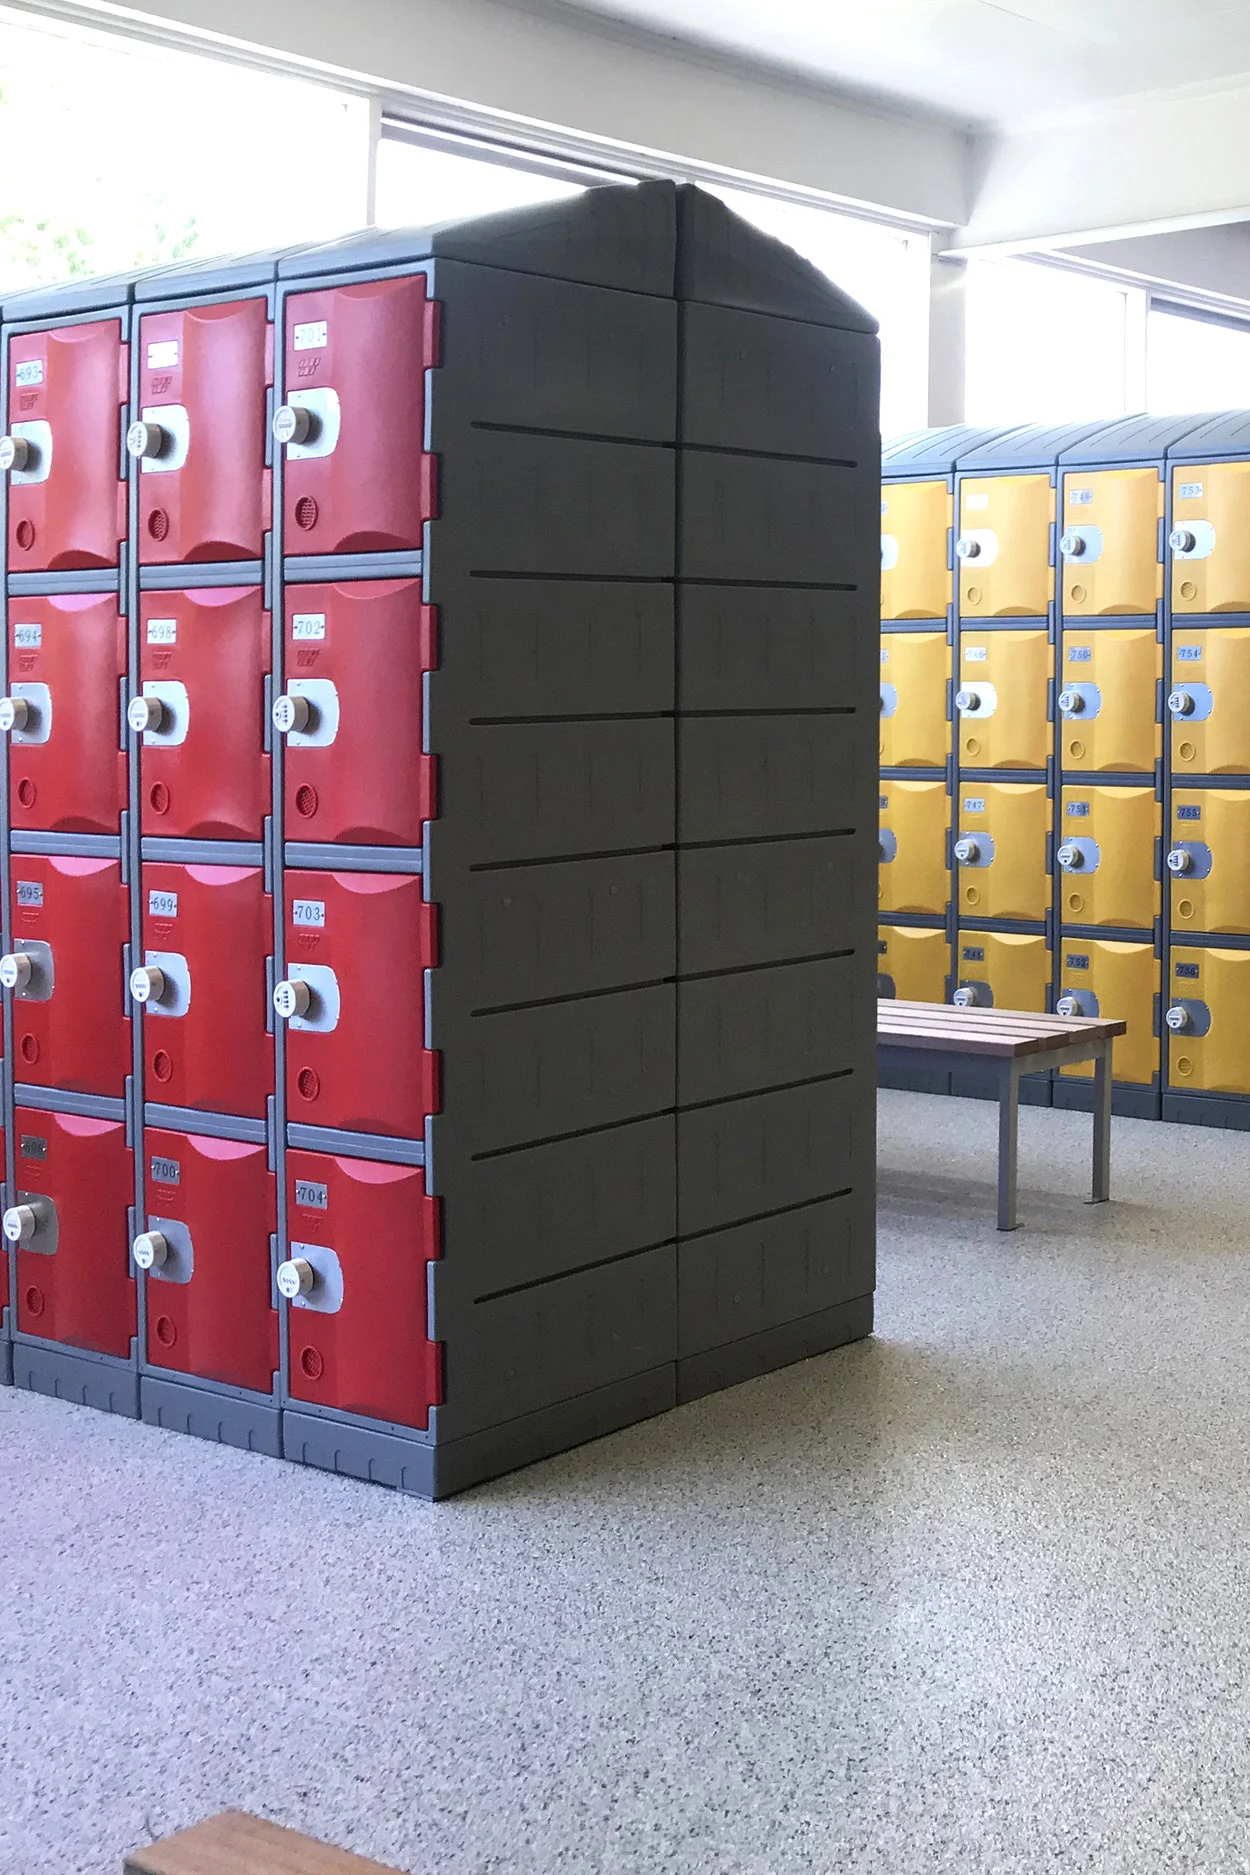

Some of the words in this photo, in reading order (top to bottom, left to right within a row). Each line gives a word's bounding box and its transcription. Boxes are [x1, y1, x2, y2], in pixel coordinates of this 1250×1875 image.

[19, 366, 39, 381] 693
[1182, 486, 1199, 495] 753
[151, 626, 172, 639] 698
[298, 620, 321, 635] 702
[18, 629, 37, 643] 694
[1181, 650, 1198, 658] 754
[967, 801, 982, 810] 747
[1070, 804, 1086, 814] 751
[20, 886, 40, 900] 695
[153, 896, 173, 912] 699
[297, 905, 320, 921] 703
[155, 1162, 176, 1178] 700
[300, 1186, 323, 1204] 704
